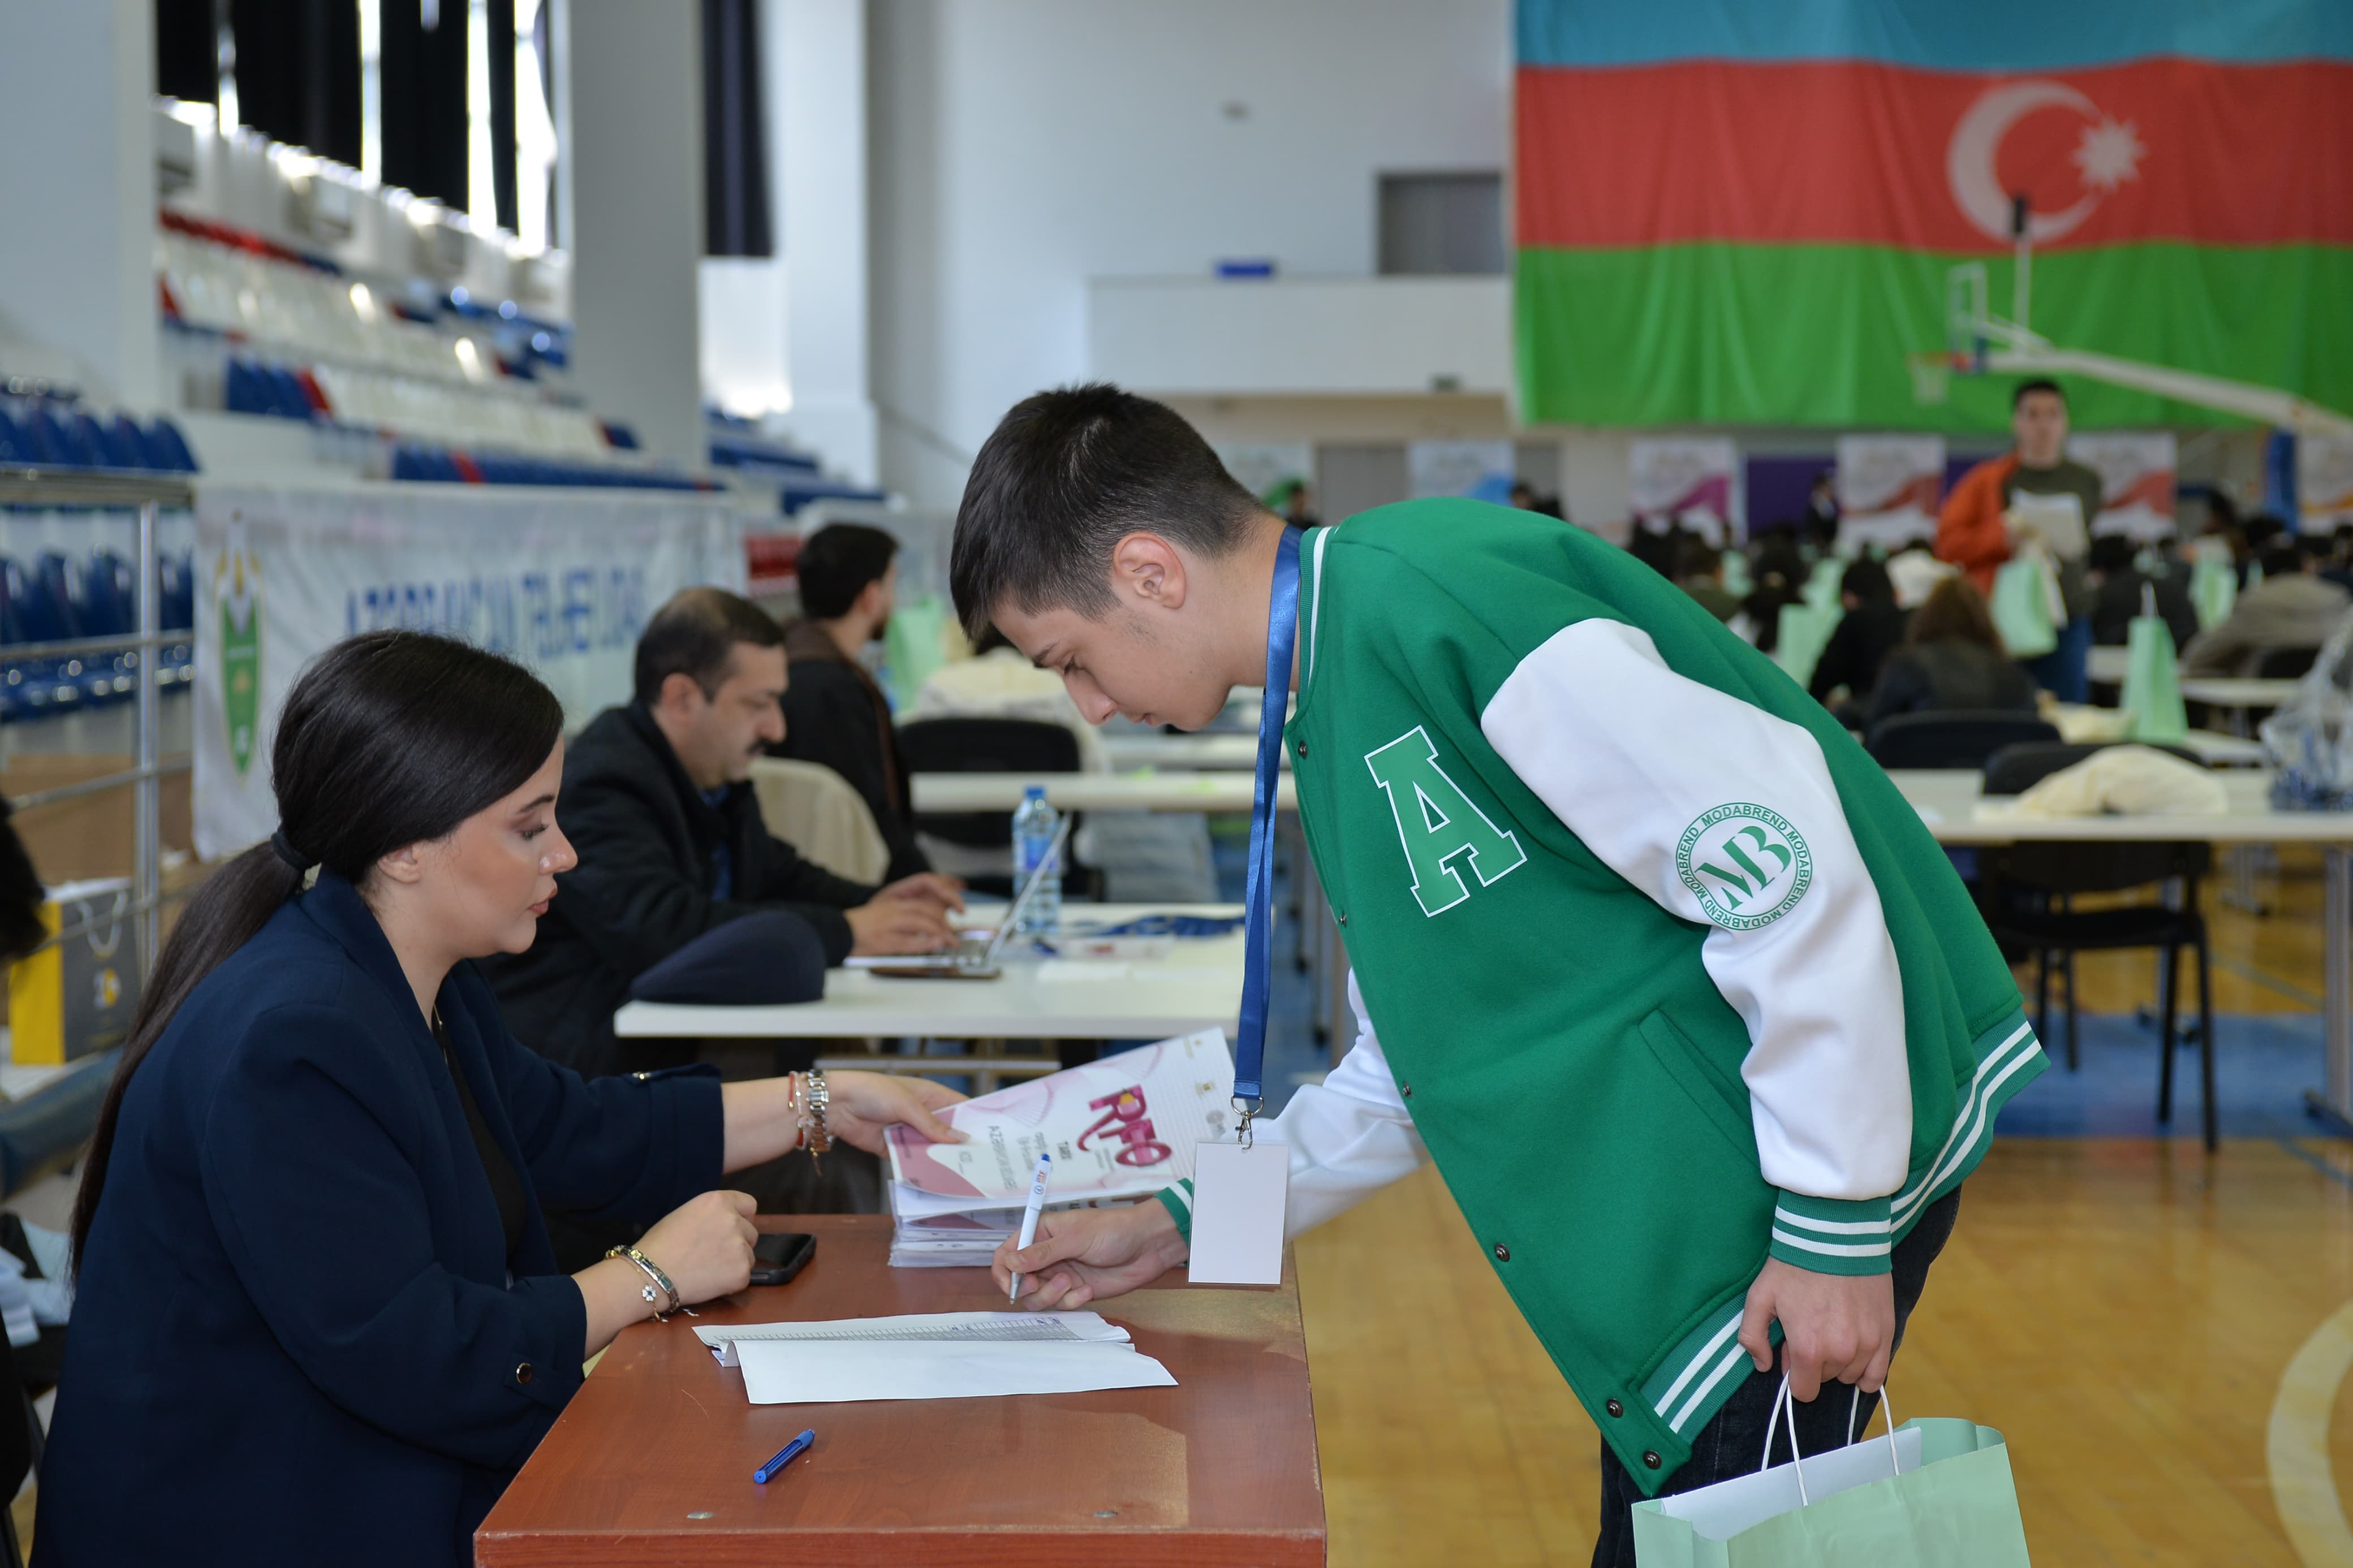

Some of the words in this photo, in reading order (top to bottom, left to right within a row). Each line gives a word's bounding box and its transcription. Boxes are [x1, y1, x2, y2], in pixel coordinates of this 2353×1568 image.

[1364, 724, 1528, 918] A
[1701, 805, 1787, 830] MODABREND
[1679, 827, 1707, 899] MODABREND
[1783, 830, 1809, 910] MODABREND
[1704, 899, 1782, 928] MODABREND
[1077, 1084, 1172, 1167] RFO
